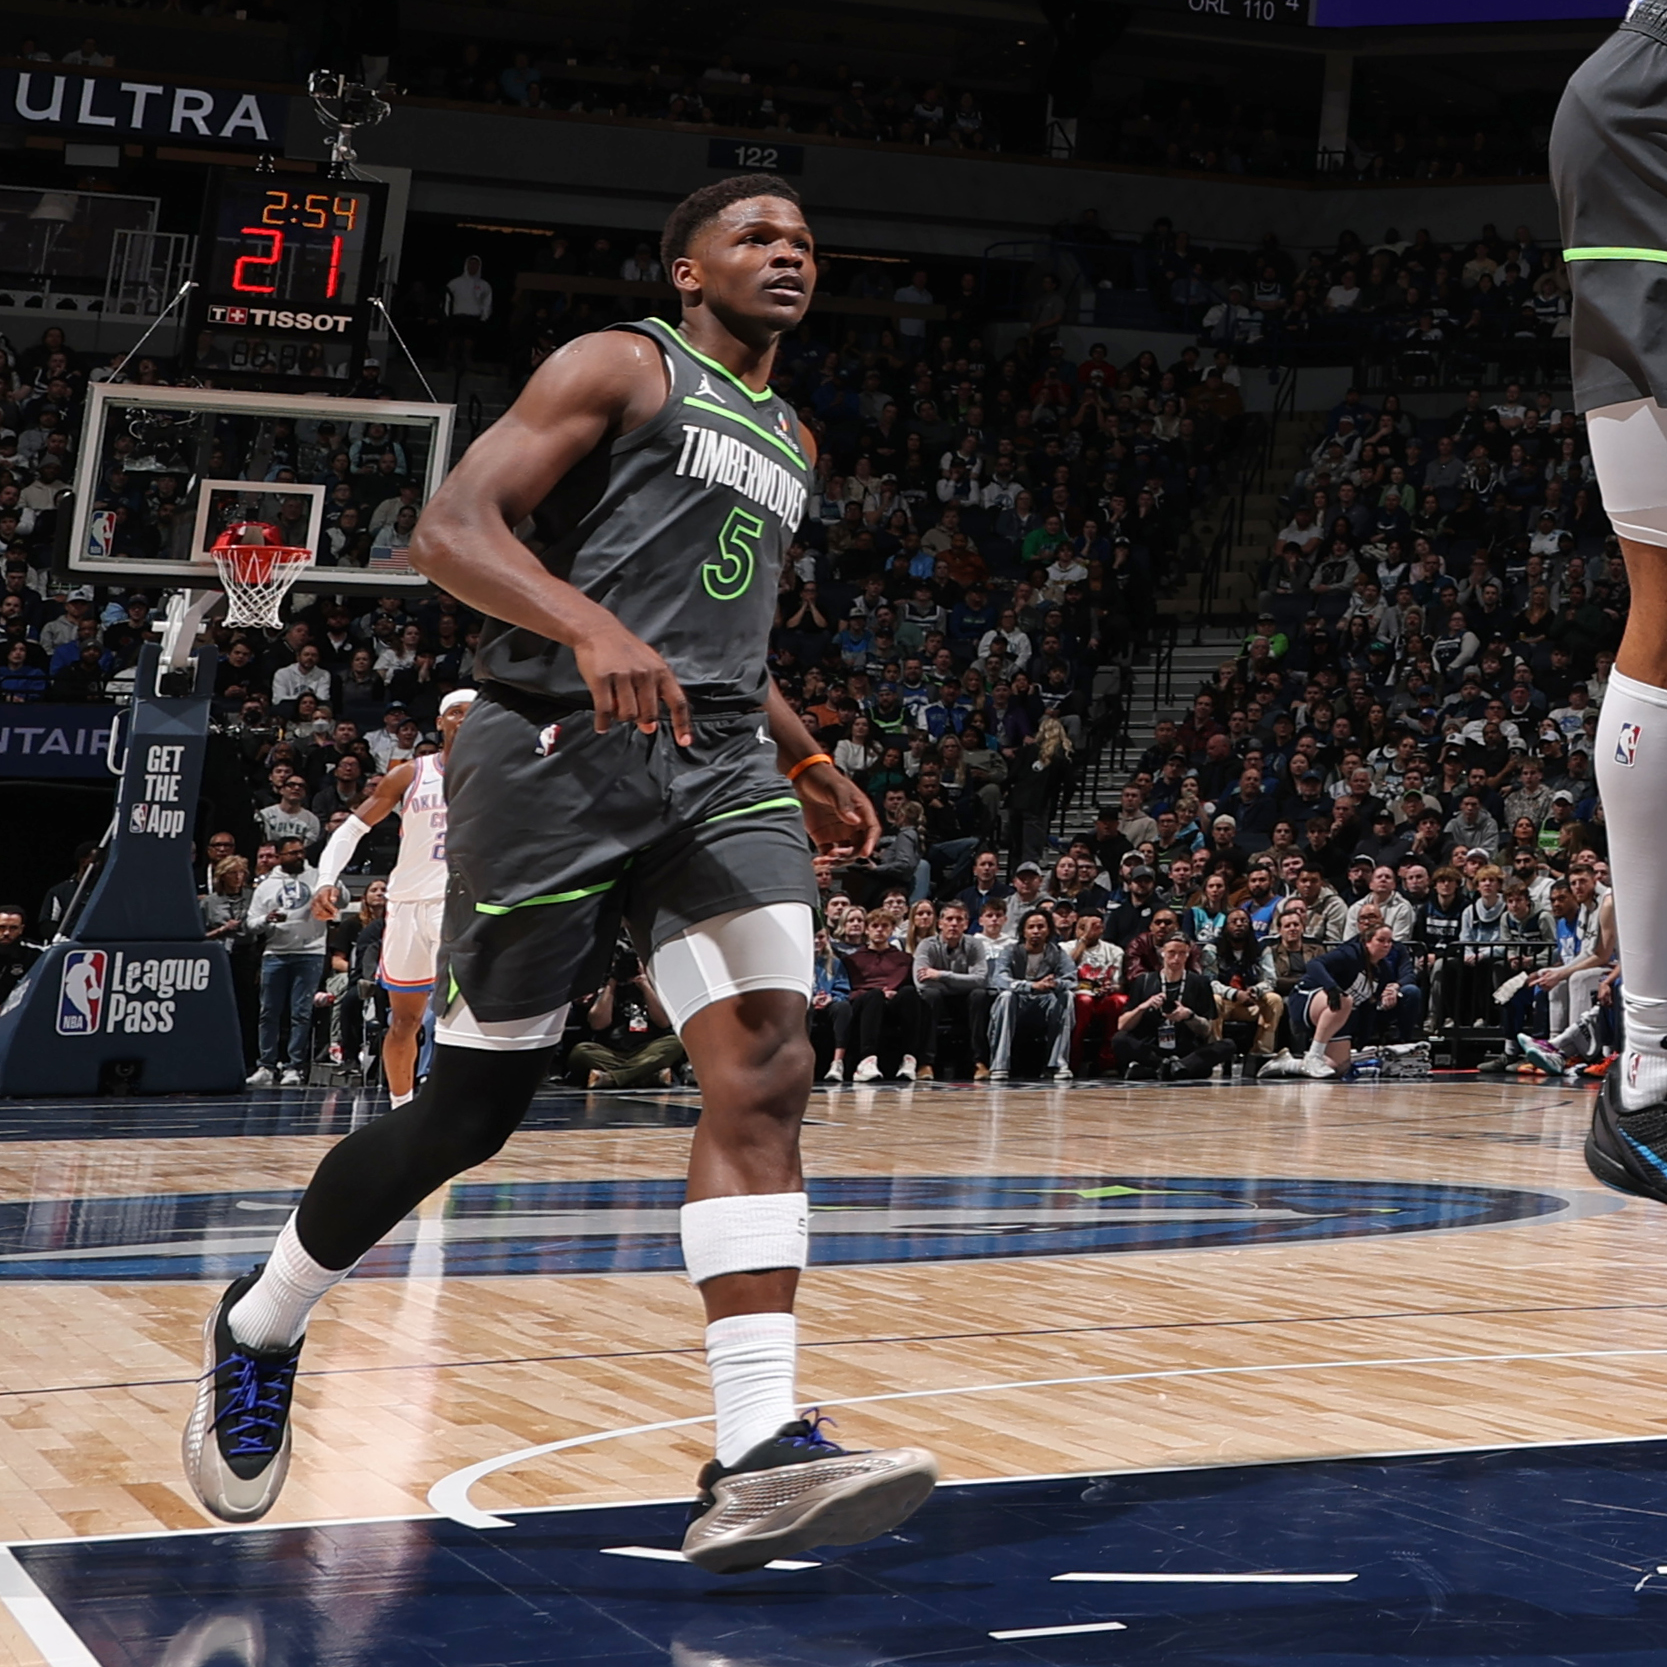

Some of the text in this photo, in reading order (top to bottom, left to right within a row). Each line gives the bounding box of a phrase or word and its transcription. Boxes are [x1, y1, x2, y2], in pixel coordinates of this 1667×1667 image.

[1242, 0, 1276, 21] 110
[14, 72, 271, 141] ULTRA
[734, 145, 779, 169] 122
[261, 189, 358, 231] 2:54
[231, 226, 344, 299] 21
[248, 307, 353, 334] TISSOT
[702, 506, 764, 601] 5
[146, 744, 186, 774] GET
[144, 773, 182, 803] THE
[146, 804, 186, 839] App
[111, 951, 211, 1000] League
[63, 1014, 84, 1030] NBA
[106, 993, 177, 1035] Pass
